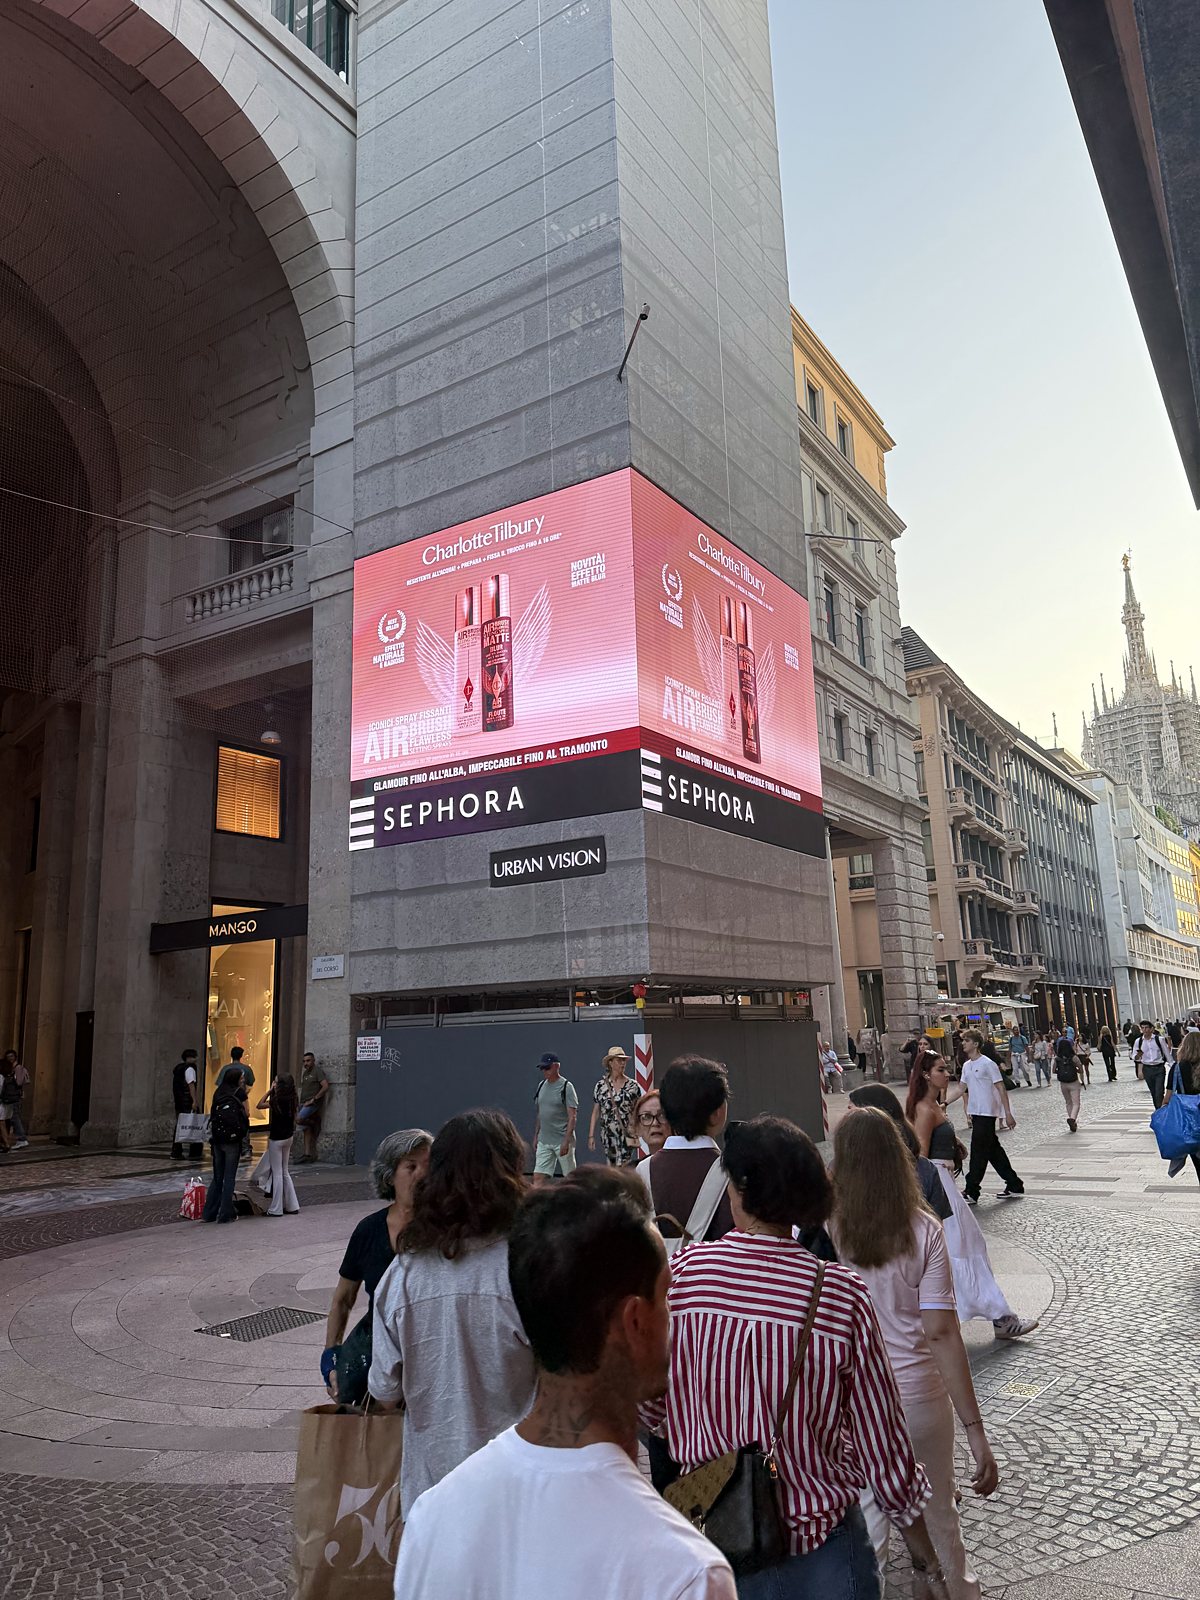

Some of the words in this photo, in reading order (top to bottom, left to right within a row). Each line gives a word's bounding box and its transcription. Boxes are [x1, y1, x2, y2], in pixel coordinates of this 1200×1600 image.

[461, 557, 482, 569] PREPARA
[571, 552, 605, 571] NOVITÀ!
[572, 564, 606, 580] EFFETTO
[572, 577, 590, 588] MATTE
[592, 573, 606, 582] BLUR
[484, 632, 510, 648] MATTE
[373, 649, 404, 664] NATURALE
[663, 685, 696, 732] AIR
[696, 700, 722, 725] BRUSH
[368, 719, 394, 731] ICONICI
[396, 713, 417, 726] SPRAY
[420, 705, 452, 718] FISSANTI
[363, 725, 409, 764] AIR
[410, 731, 452, 747] FLAWLESS
[676, 747, 700, 764] GLAMOUR
[374, 776, 408, 792] GLAMOUR
[410, 773, 428, 785] FINO
[429, 765, 467, 781] ALL'ALBA,
[469, 756, 522, 774] IMPECCABILE
[524, 753, 543, 764] FINO
[546, 750, 557, 759] AL
[560, 739, 608, 757] TRAMONTO
[383, 786, 524, 830] SEPHORA
[668, 775, 755, 824] SEPHORA
[494, 856, 543, 878] URBAN
[547, 848, 600, 869] VISION
[209, 920, 257, 937] MANGO
